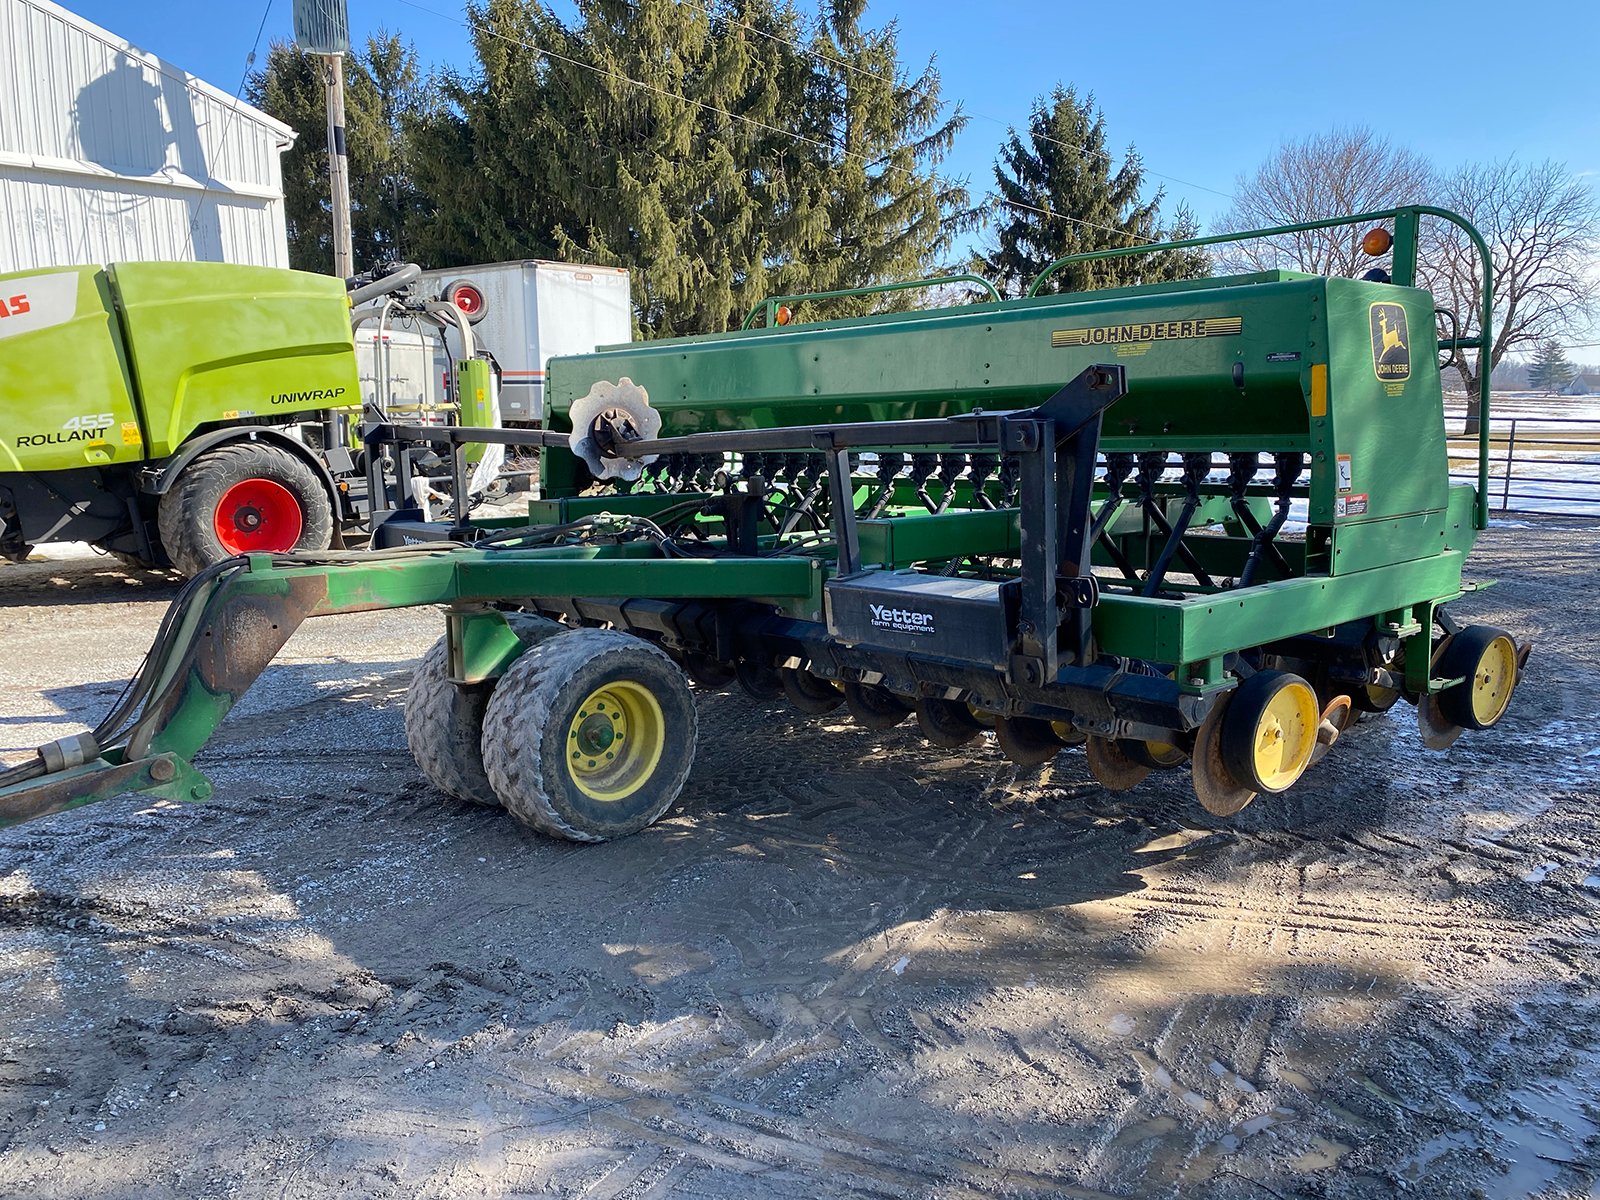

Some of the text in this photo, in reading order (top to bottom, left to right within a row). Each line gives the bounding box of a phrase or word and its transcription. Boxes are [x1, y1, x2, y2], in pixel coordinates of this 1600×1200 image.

[1080, 320, 1207, 345] JOHN DEERE
[1377, 364, 1408, 374] JOHN DEERE
[270, 387, 345, 405] UNIWRAP
[63, 413, 115, 431] 455
[16, 427, 107, 448] ROLLANT
[402, 535, 427, 546] Yette
[869, 604, 933, 625] Yetter
[871, 619, 890, 627] farm
[892, 621, 935, 633] equipment
